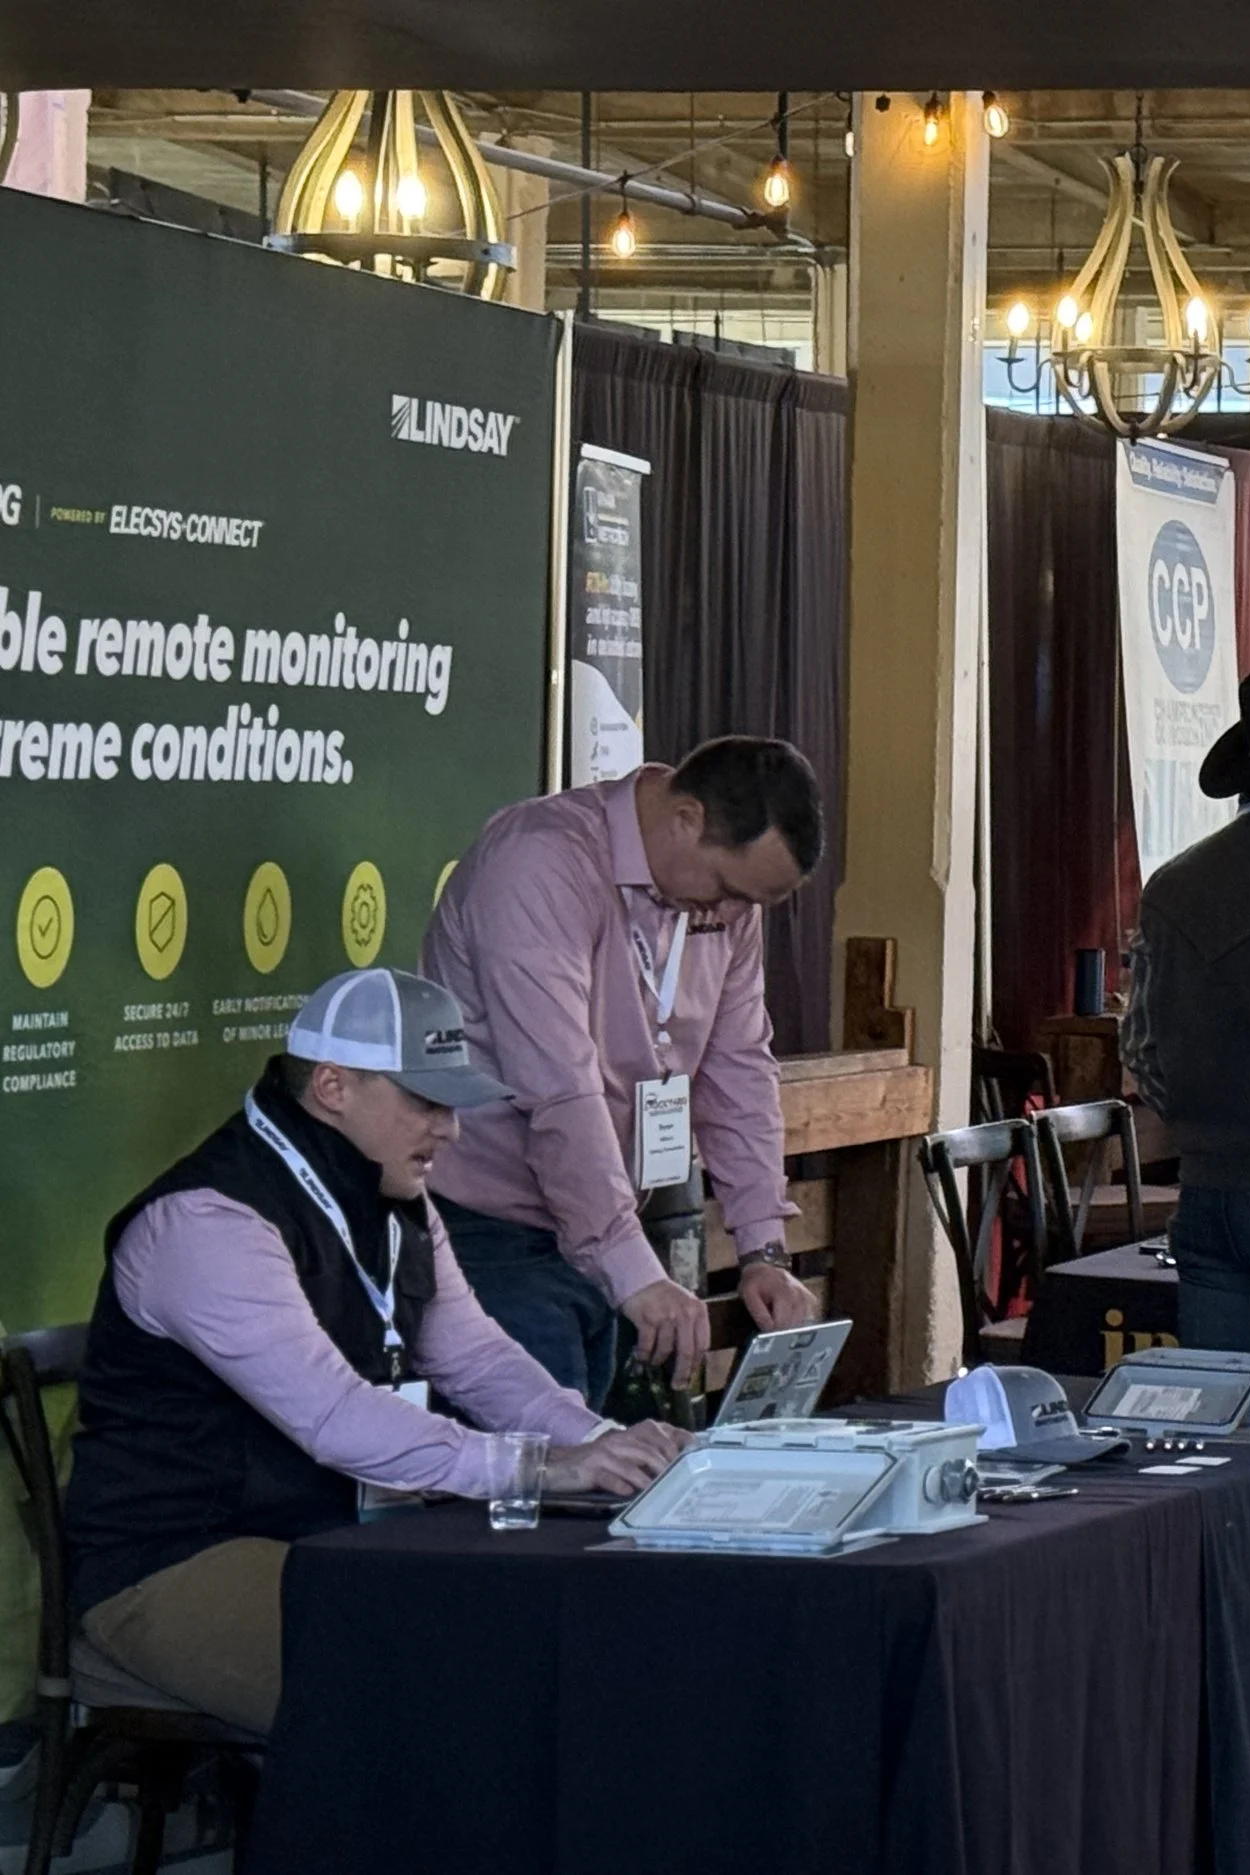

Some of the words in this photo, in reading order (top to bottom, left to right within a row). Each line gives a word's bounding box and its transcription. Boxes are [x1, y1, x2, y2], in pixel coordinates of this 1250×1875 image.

[409, 398, 515, 456] LINDSAY
[1152, 559, 1208, 651] CCP
[75, 614, 235, 682] remote
[241, 612, 453, 716] monitoring
[0, 719, 122, 781] reme
[131, 702, 354, 785] conditions.
[124, 1004, 163, 1021] SECURE
[212, 999, 242, 1015] EARLY
[12, 1011, 69, 1031] MAINTAIN
[114, 1034, 154, 1052] ACCESS
[156, 1032, 170, 1048] TO
[172, 1030, 199, 1047] DATA
[222, 1026, 236, 1042] OF
[3, 1040, 76, 1062] REGULATORY
[3, 1070, 77, 1093] COMPLIANCE
